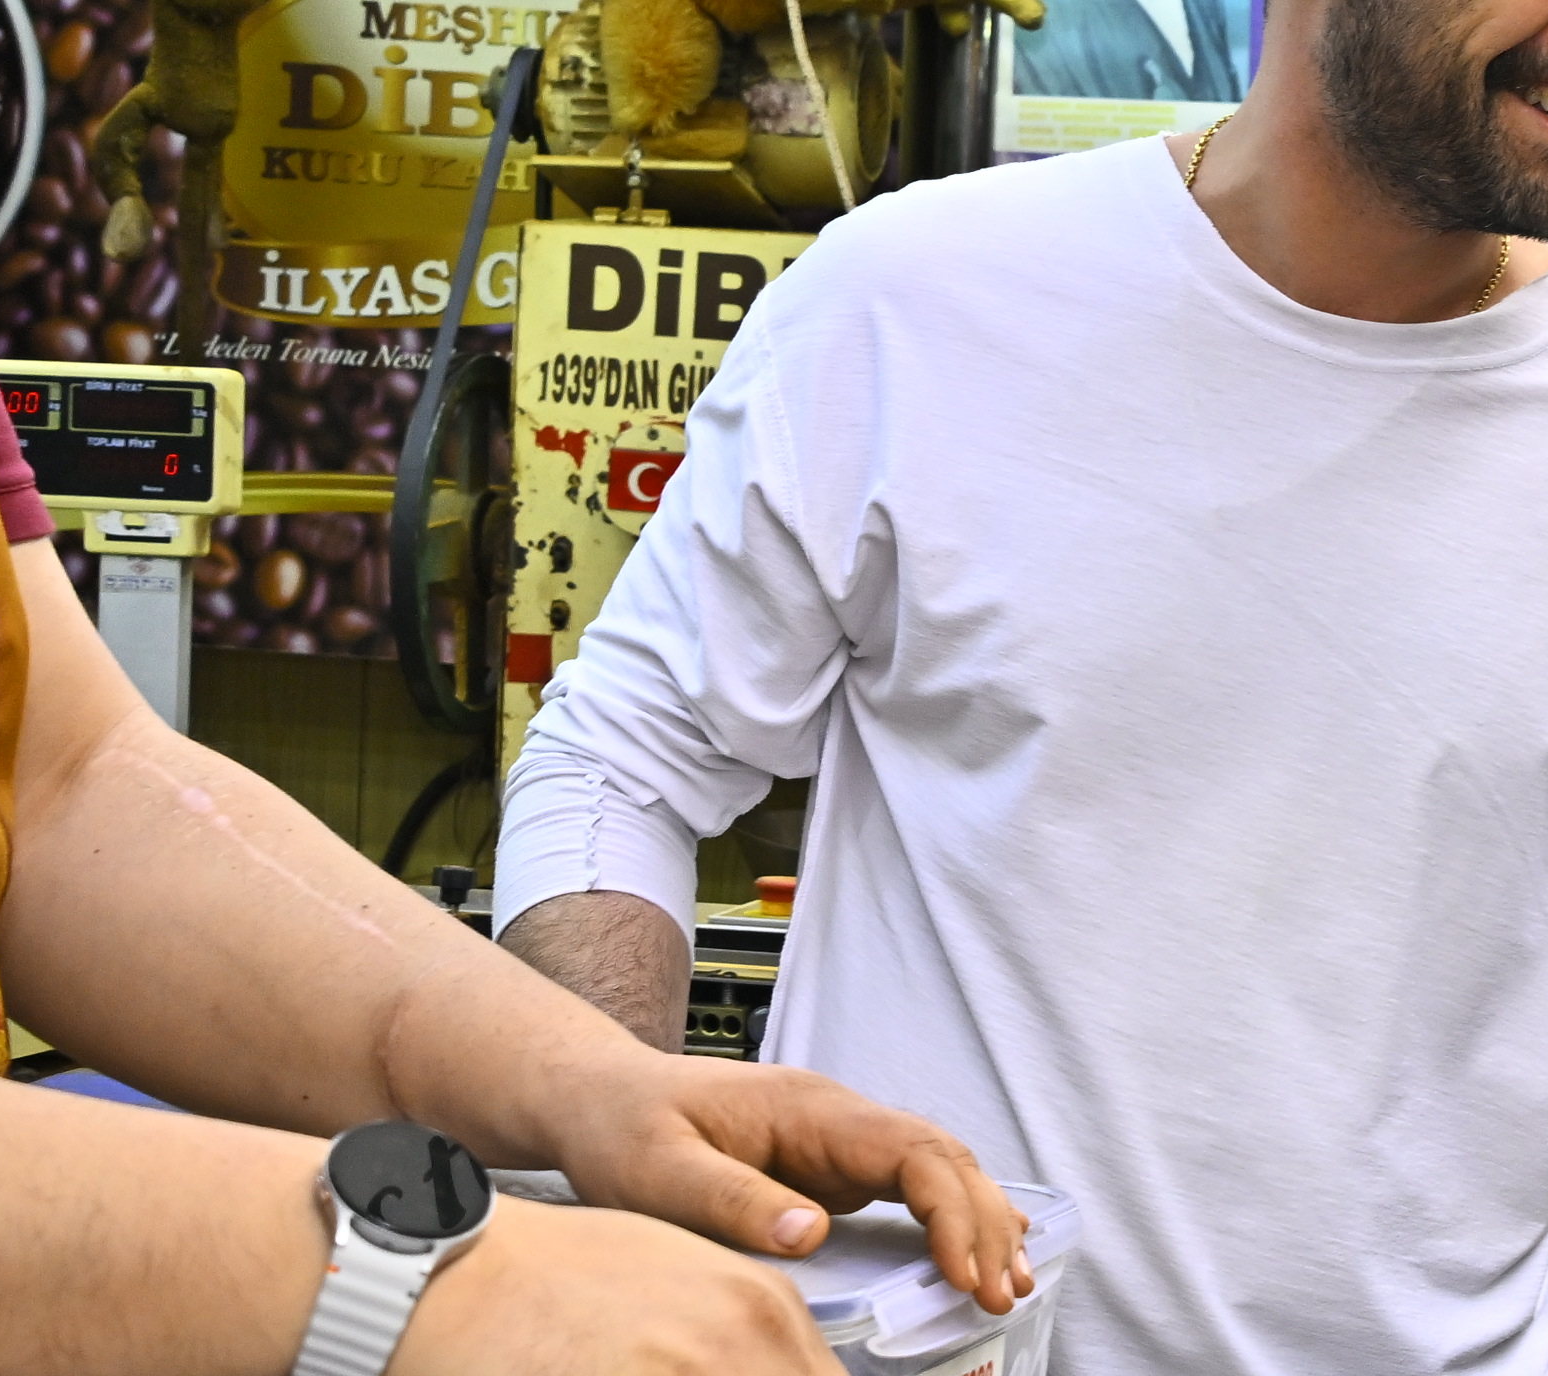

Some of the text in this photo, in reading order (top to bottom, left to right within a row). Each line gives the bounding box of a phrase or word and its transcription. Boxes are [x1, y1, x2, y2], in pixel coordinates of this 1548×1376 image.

[259, 248, 451, 316] İLYAS
[278, 337, 369, 369] Toruna
[537, 353, 660, 410] 1939'DAN
[87, 437, 157, 449] TOPLAM FİYAT
[164, 453, 180, 475] 0
